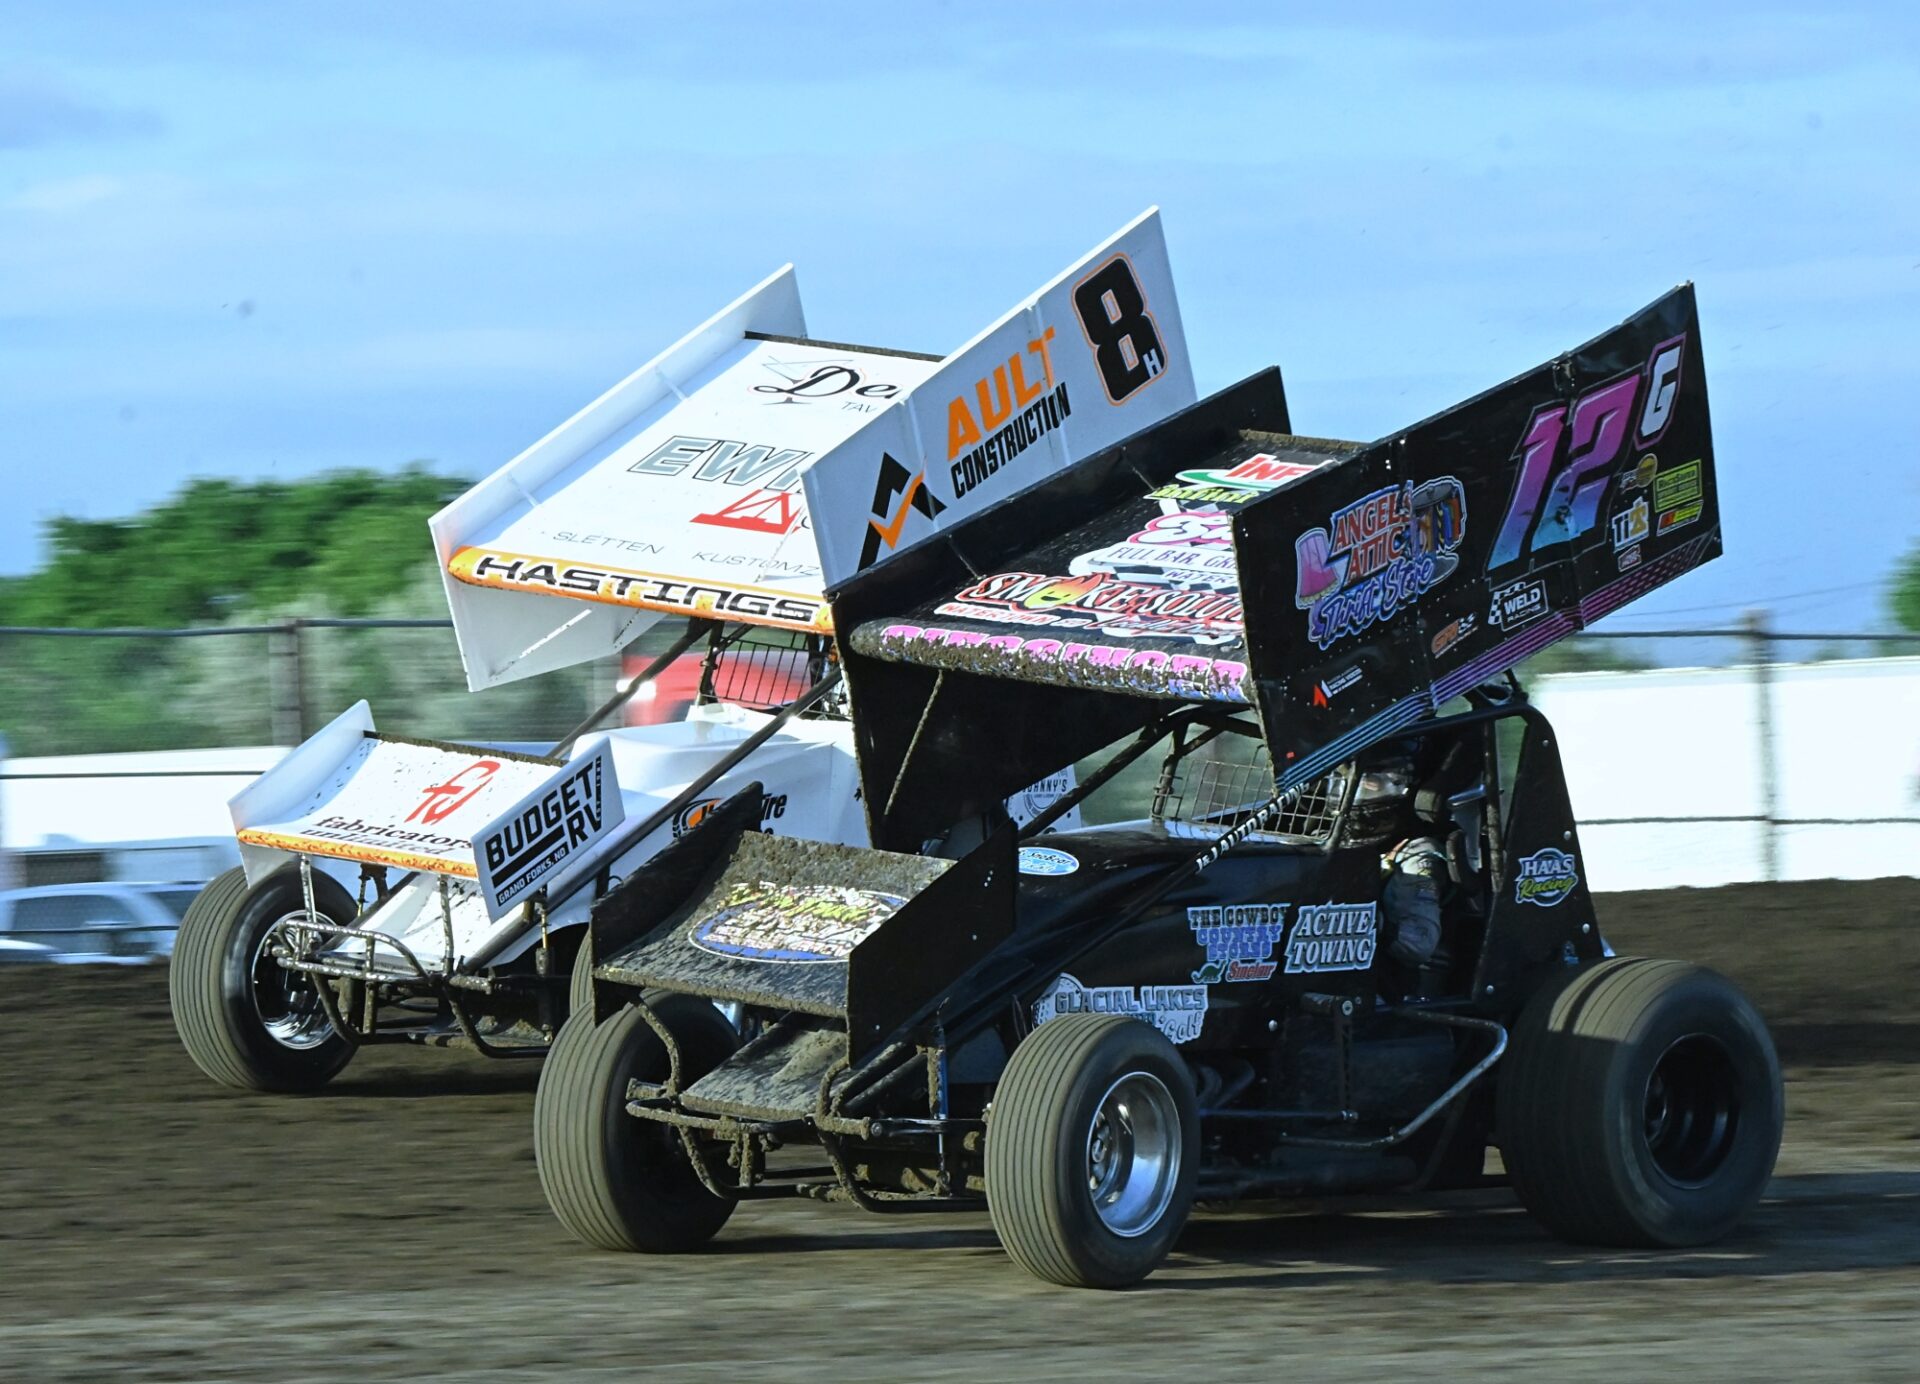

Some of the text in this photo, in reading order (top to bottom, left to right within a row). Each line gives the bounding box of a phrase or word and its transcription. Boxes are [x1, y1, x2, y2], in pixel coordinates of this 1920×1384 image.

[947, 325, 1057, 462] AULT
[950, 381, 1072, 500] CONSTRUCTION
[1334, 491, 1412, 553] ANGELS
[553, 531, 820, 577] SLETTEN KUSTOMZ
[1108, 546, 1153, 561] FULL
[1154, 550, 1200, 566] BAR
[1345, 523, 1407, 587] ATTIC
[476, 556, 820, 623] HASTINGS
[1321, 579, 1380, 642] Thrift
[1382, 557, 1434, 611] Store
[1503, 587, 1541, 616] WELD
[313, 816, 472, 849] fabricators
[485, 761, 594, 872] BUDGET
[567, 803, 602, 850] RV
[498, 878, 526, 904] GRAND
[554, 848, 567, 862] ND
[1523, 858, 1573, 877] HAAS
[1519, 877, 1575, 899] Racing
[1190, 905, 1288, 929] THE COWBOY
[1297, 910, 1372, 938] ACTIVE
[1293, 938, 1372, 966] TOWING
[1228, 960, 1275, 980] Sinclair
[1056, 988, 1206, 1014] GLACIAL LAKES
[1163, 1011, 1201, 1041] Golf
